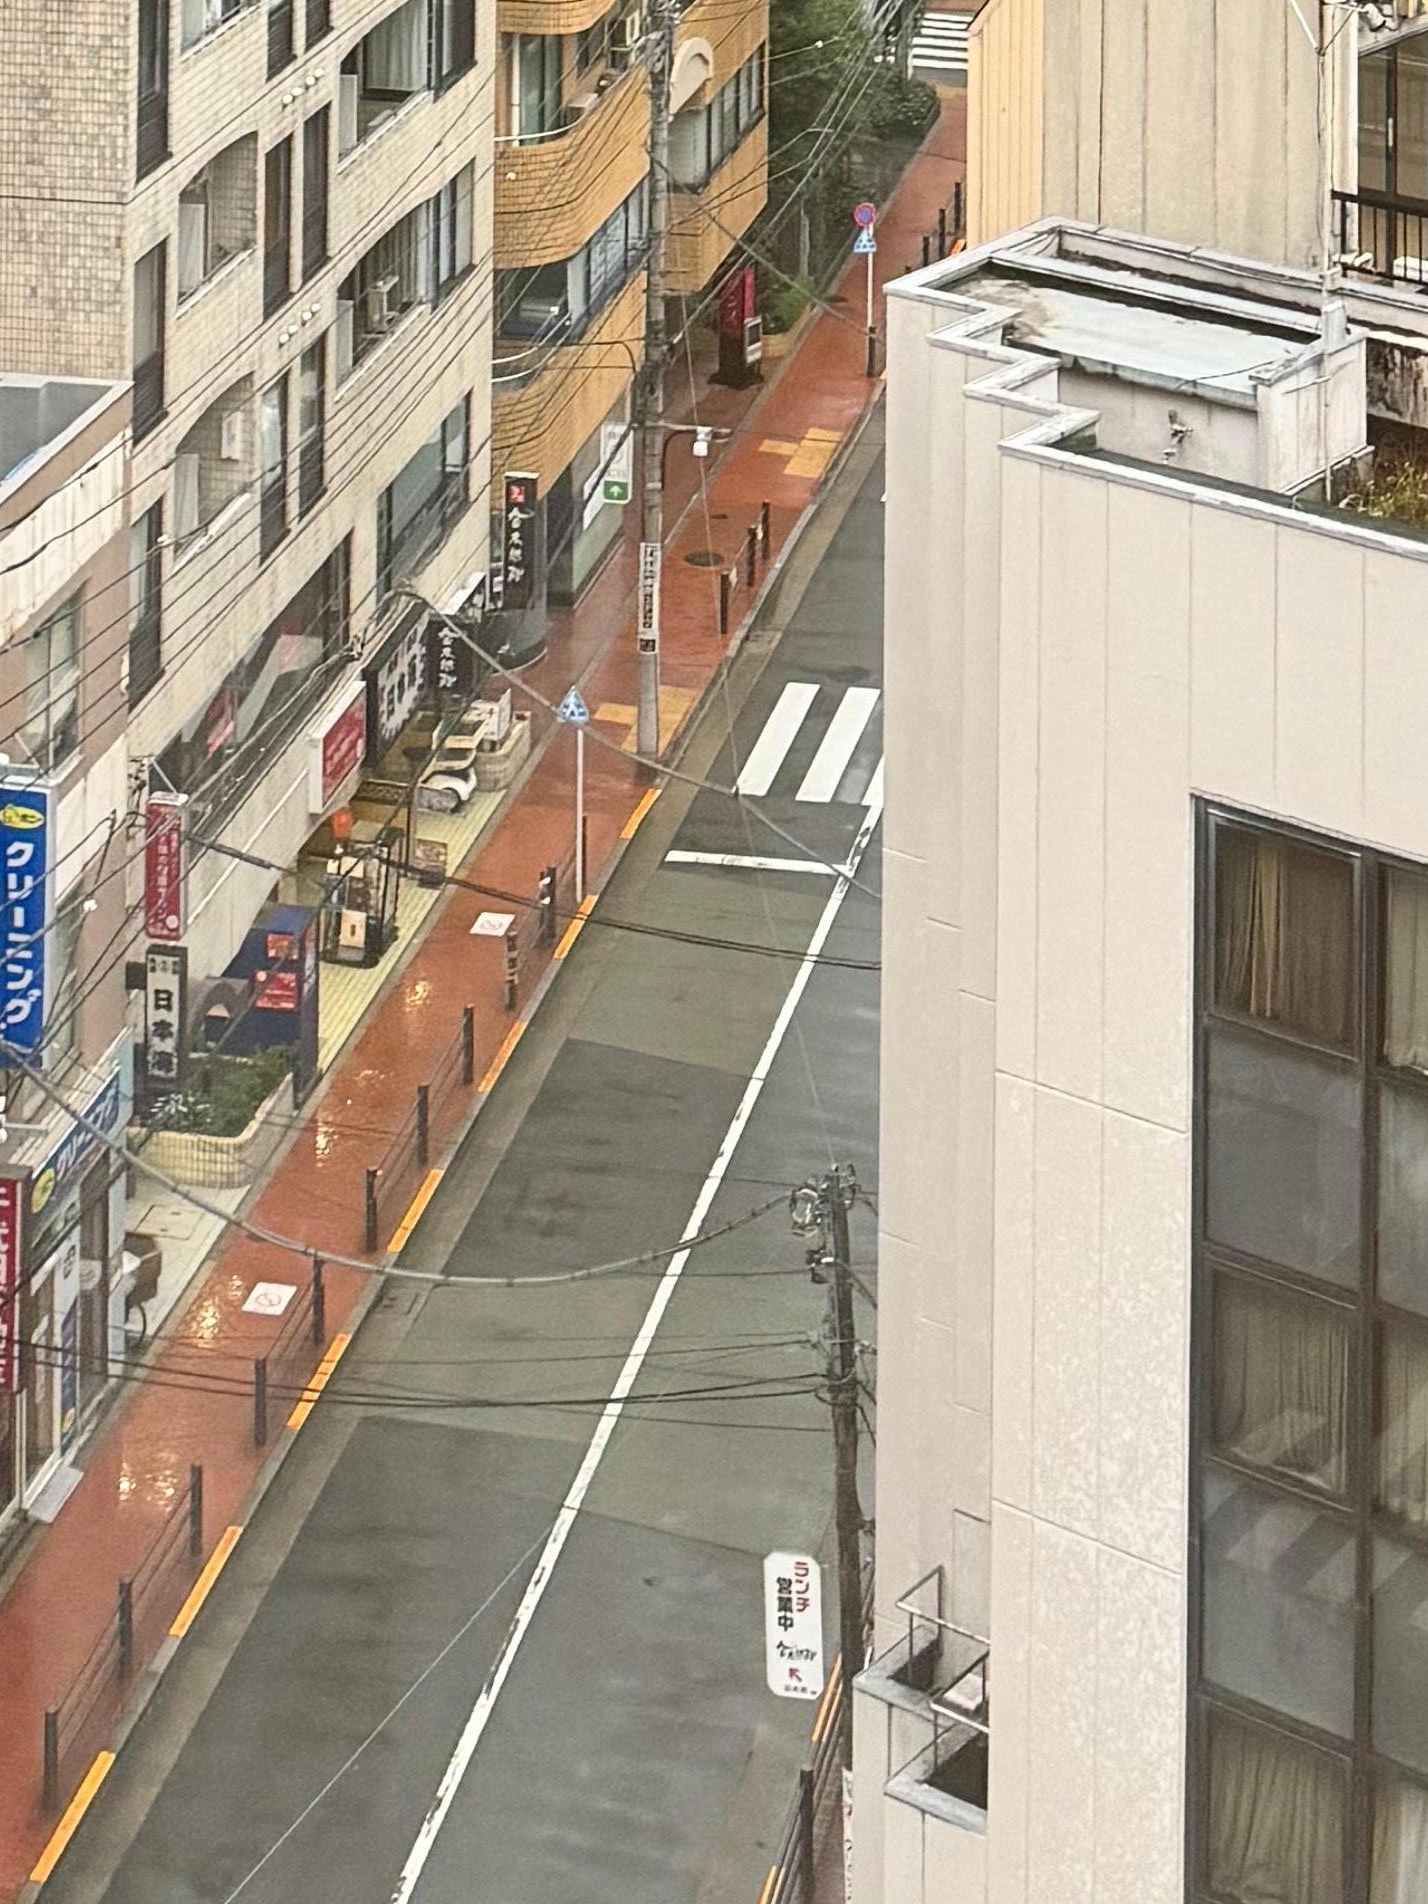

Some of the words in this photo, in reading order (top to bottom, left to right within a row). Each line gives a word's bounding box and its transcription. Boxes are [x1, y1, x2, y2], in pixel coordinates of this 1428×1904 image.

[5, 840, 42, 1025] クリーニング
[776, 1576, 794, 1632] 営業中
